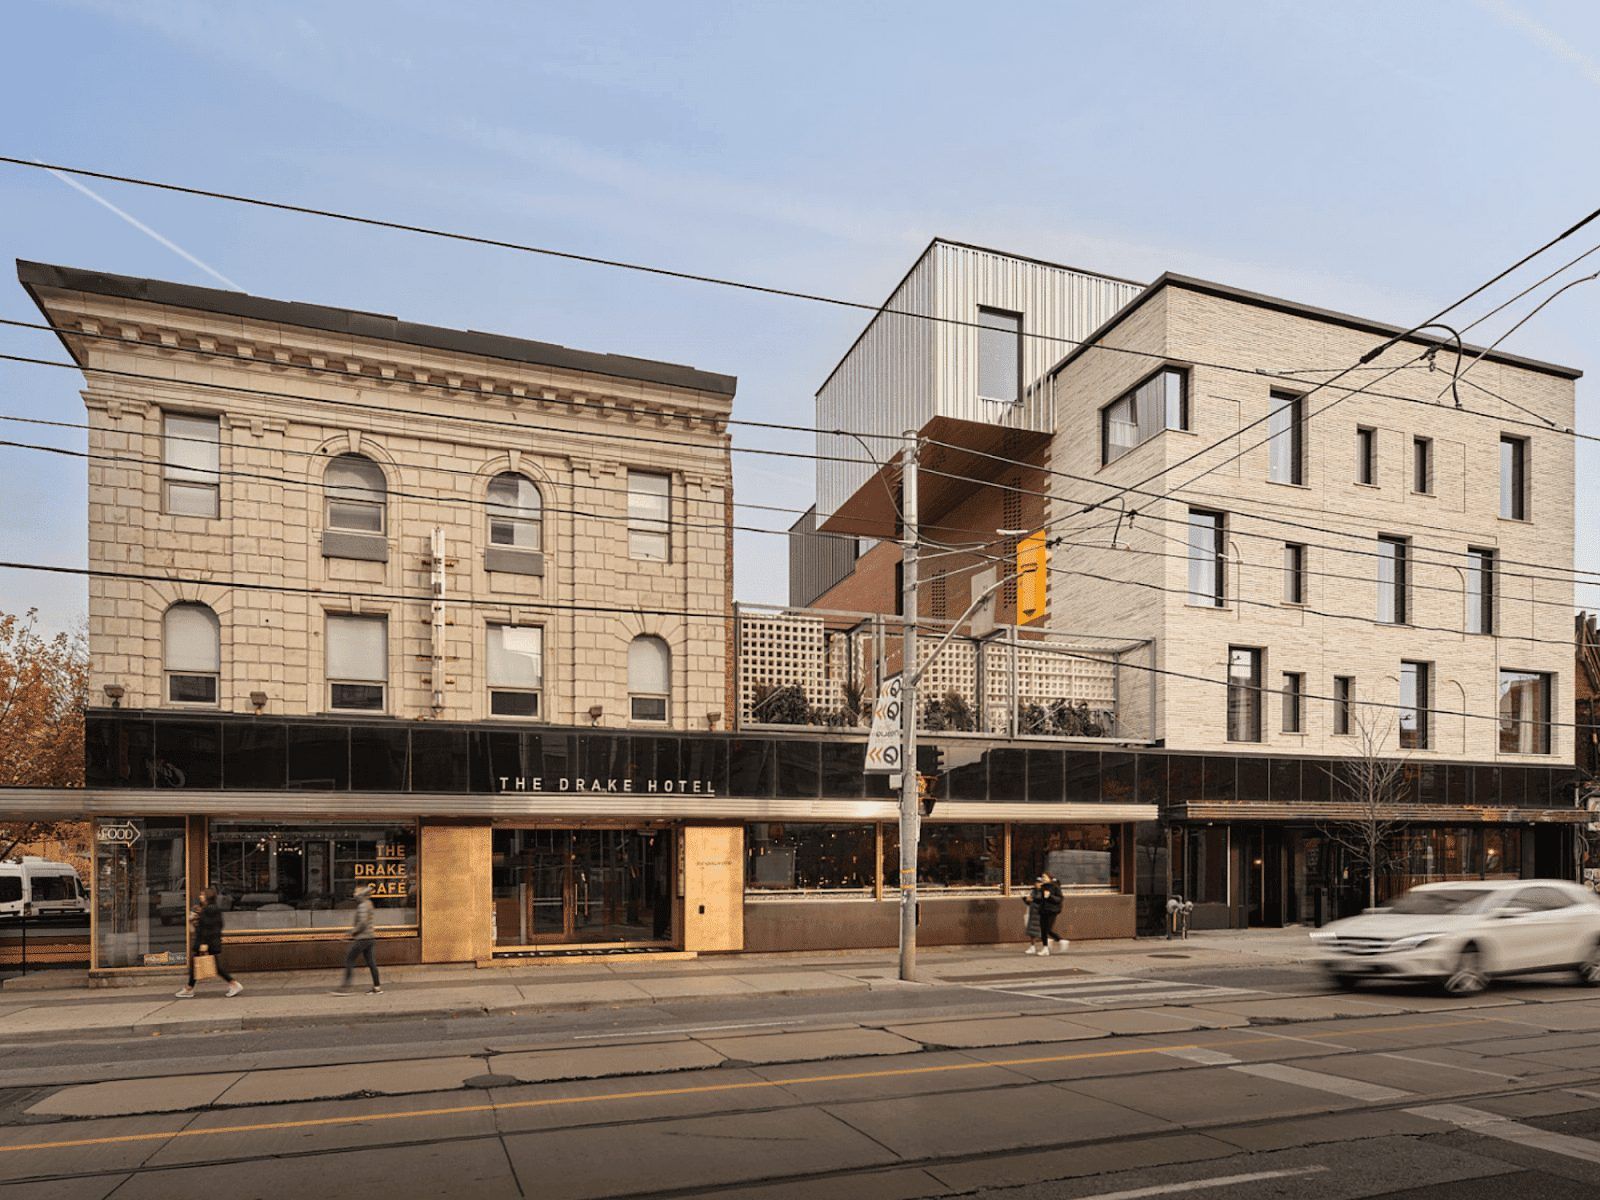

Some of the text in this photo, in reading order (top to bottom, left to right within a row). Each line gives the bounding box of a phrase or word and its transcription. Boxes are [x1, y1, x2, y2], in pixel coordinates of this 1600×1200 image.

[499, 777, 715, 793] THE DRAKE HOTEL
[100, 827, 133, 840] FOOD
[376, 844, 406, 857] THE
[354, 863, 406, 876] DRAKE
